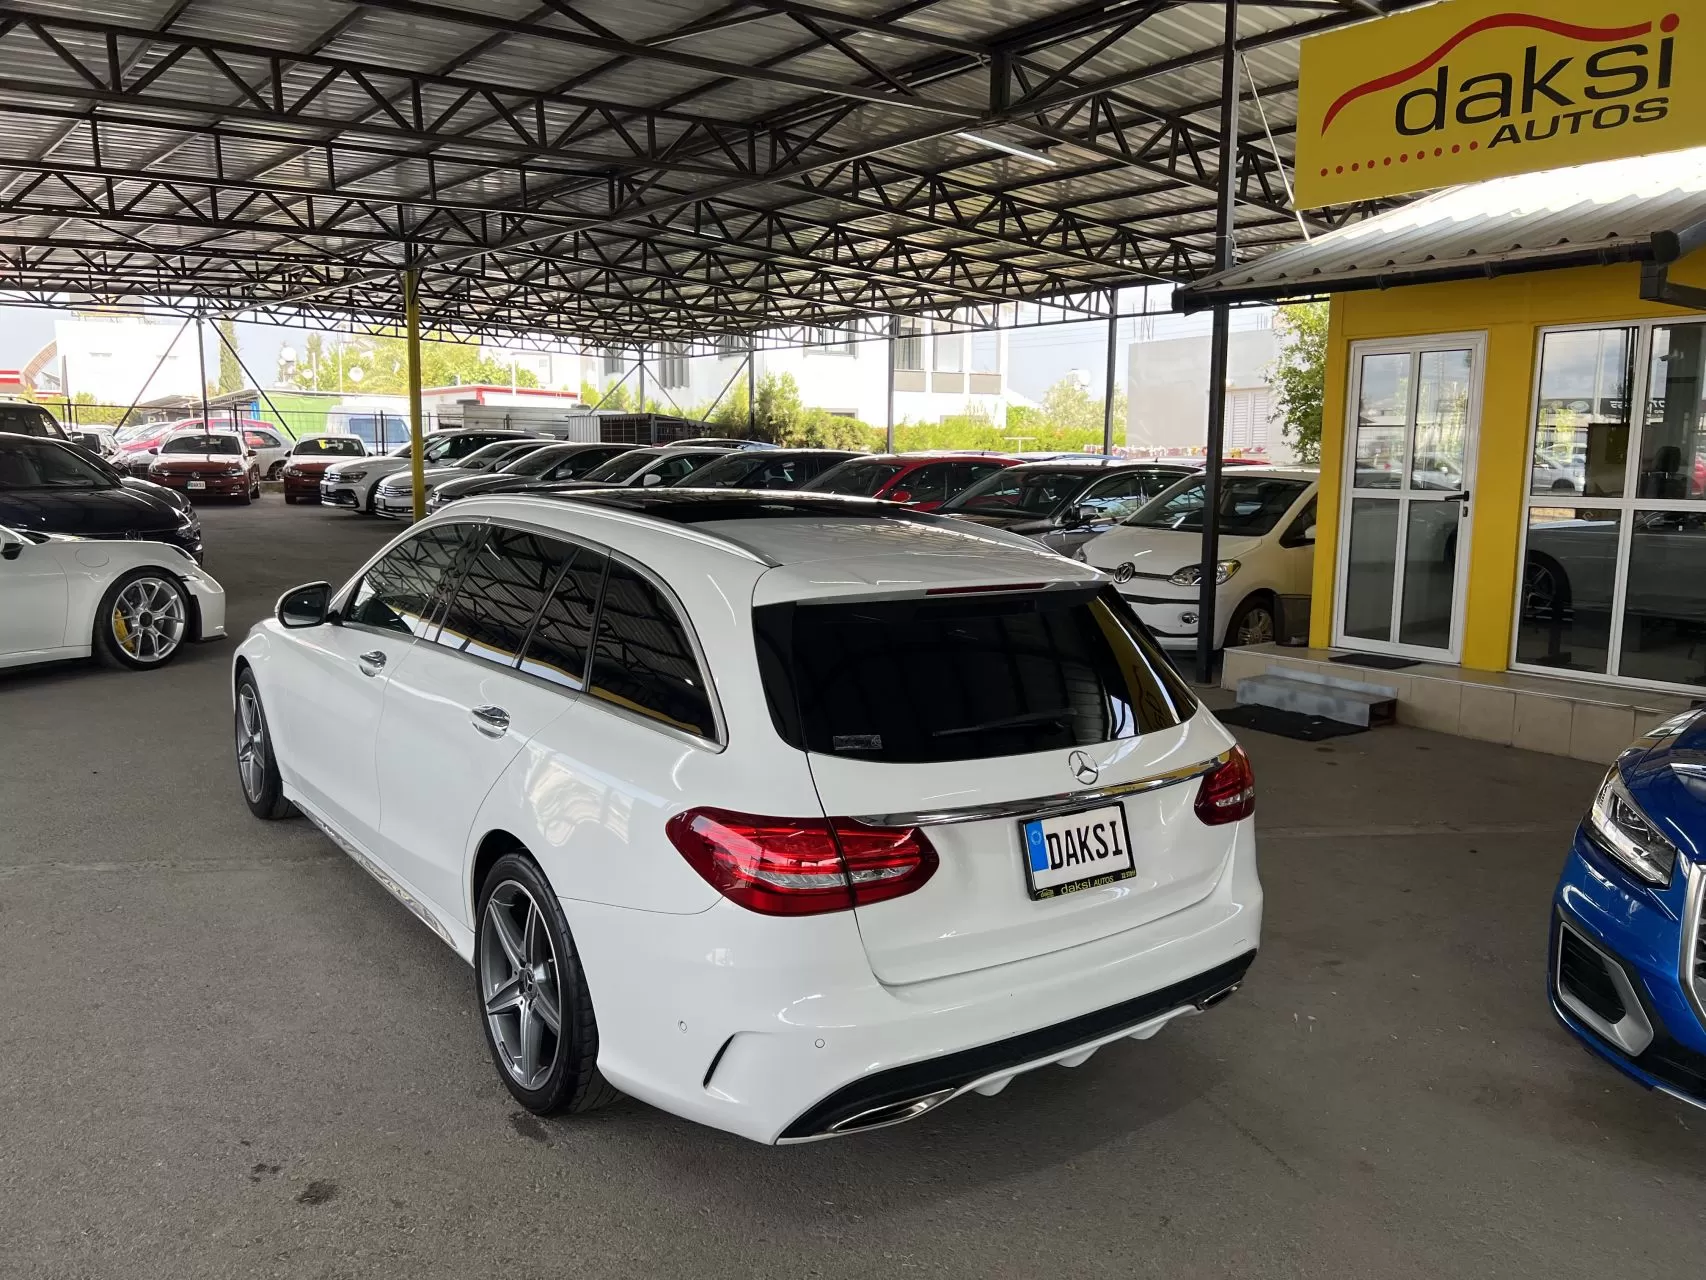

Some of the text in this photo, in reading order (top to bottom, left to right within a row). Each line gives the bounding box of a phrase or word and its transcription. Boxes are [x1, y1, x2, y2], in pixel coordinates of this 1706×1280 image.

[1395, 13, 1680, 137] daksi
[1487, 97, 1670, 149] AUTOS
[1046, 820, 1123, 870] DAKSI
[1061, 879, 1091, 895] daksi
[1093, 875, 1114, 887] AUTOS
